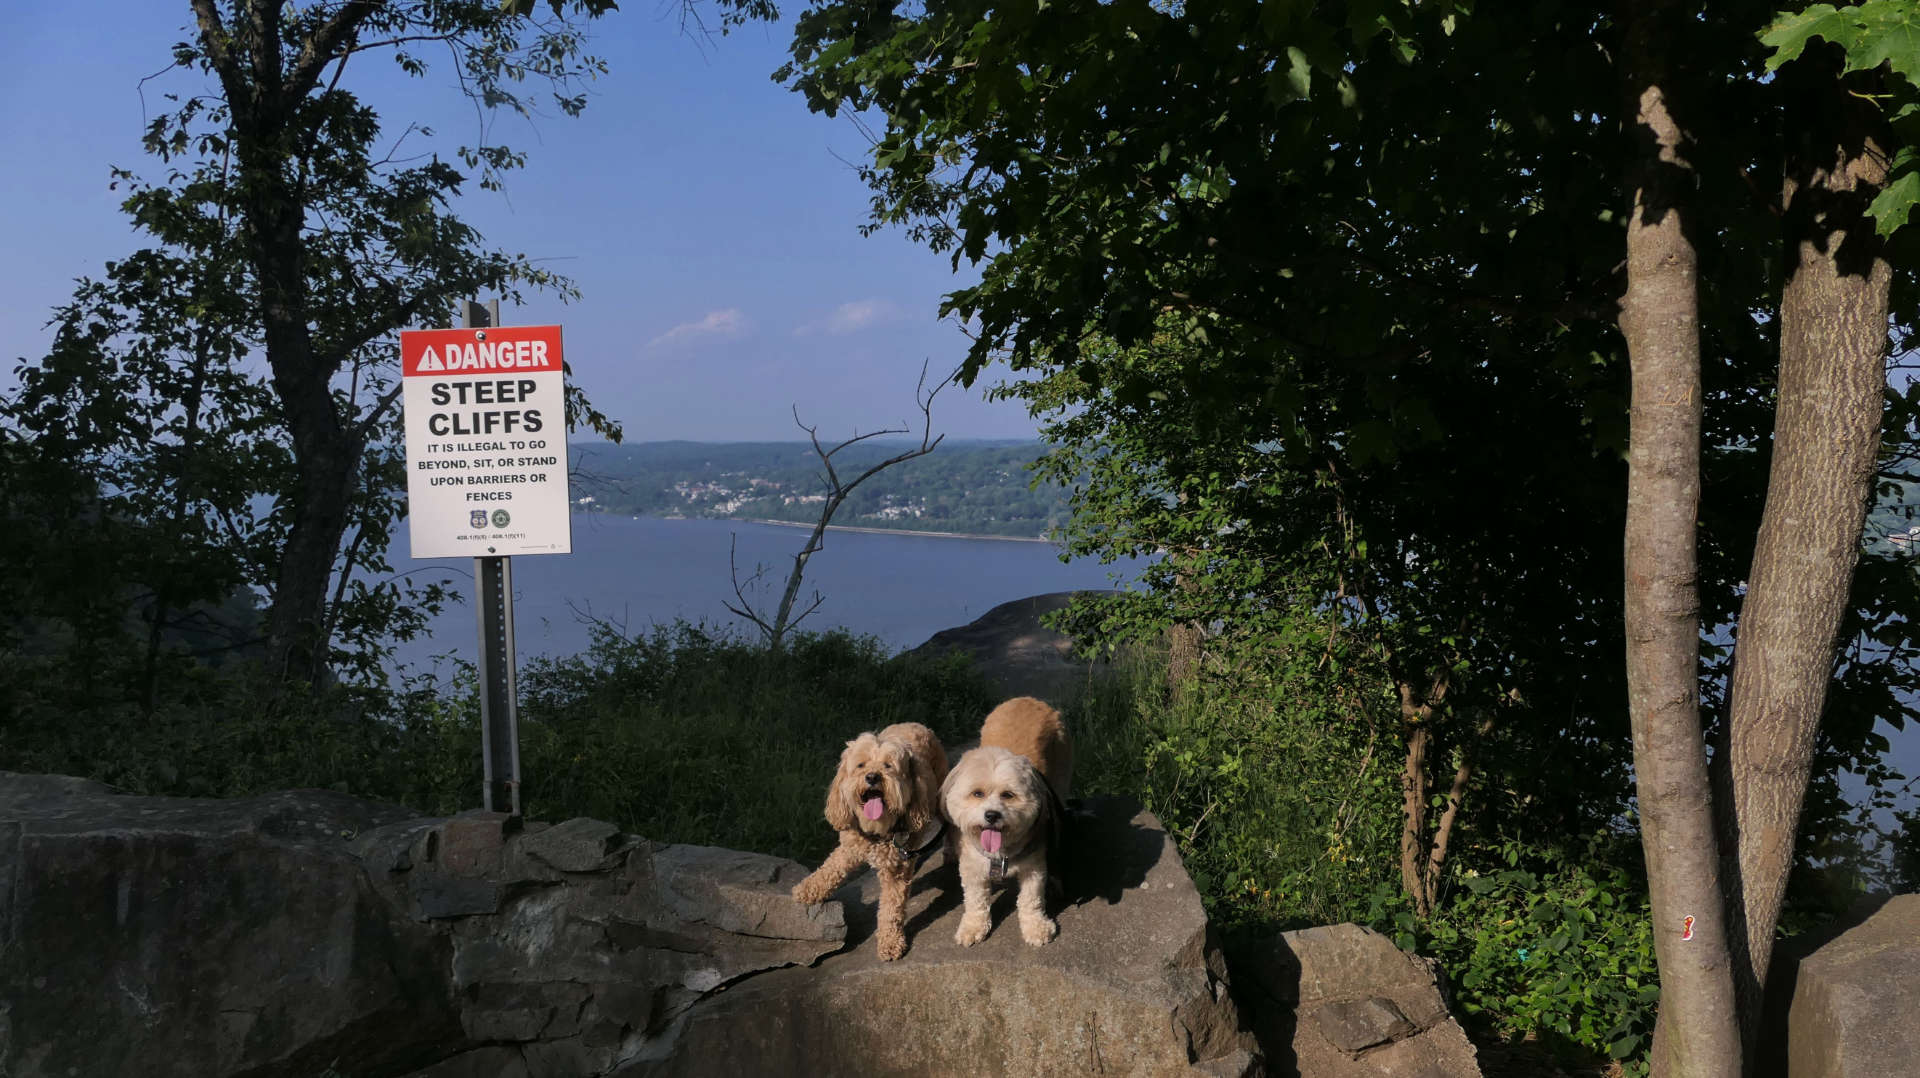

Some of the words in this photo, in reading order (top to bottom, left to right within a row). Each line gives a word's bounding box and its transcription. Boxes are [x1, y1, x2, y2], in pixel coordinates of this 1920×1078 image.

[446, 341, 548, 370] DANGER
[432, 380, 536, 405] STEEP
[429, 410, 542, 436] CLIFFS
[428, 444, 438, 452] IT
[443, 444, 453, 452] IS
[457, 442, 506, 451] ILLEGAL
[510, 441, 525, 450] TO
[529, 441, 546, 449] GO
[419, 460, 470, 470] BEYOND,
[474, 459, 494, 468] SIT,
[498, 458, 514, 467] OR
[519, 457, 557, 466] STAND
[431, 477, 463, 486] UPON
[468, 475, 526, 485] BARRIERS
[530, 474, 546, 482] OR
[466, 492, 512, 501] FENCES
